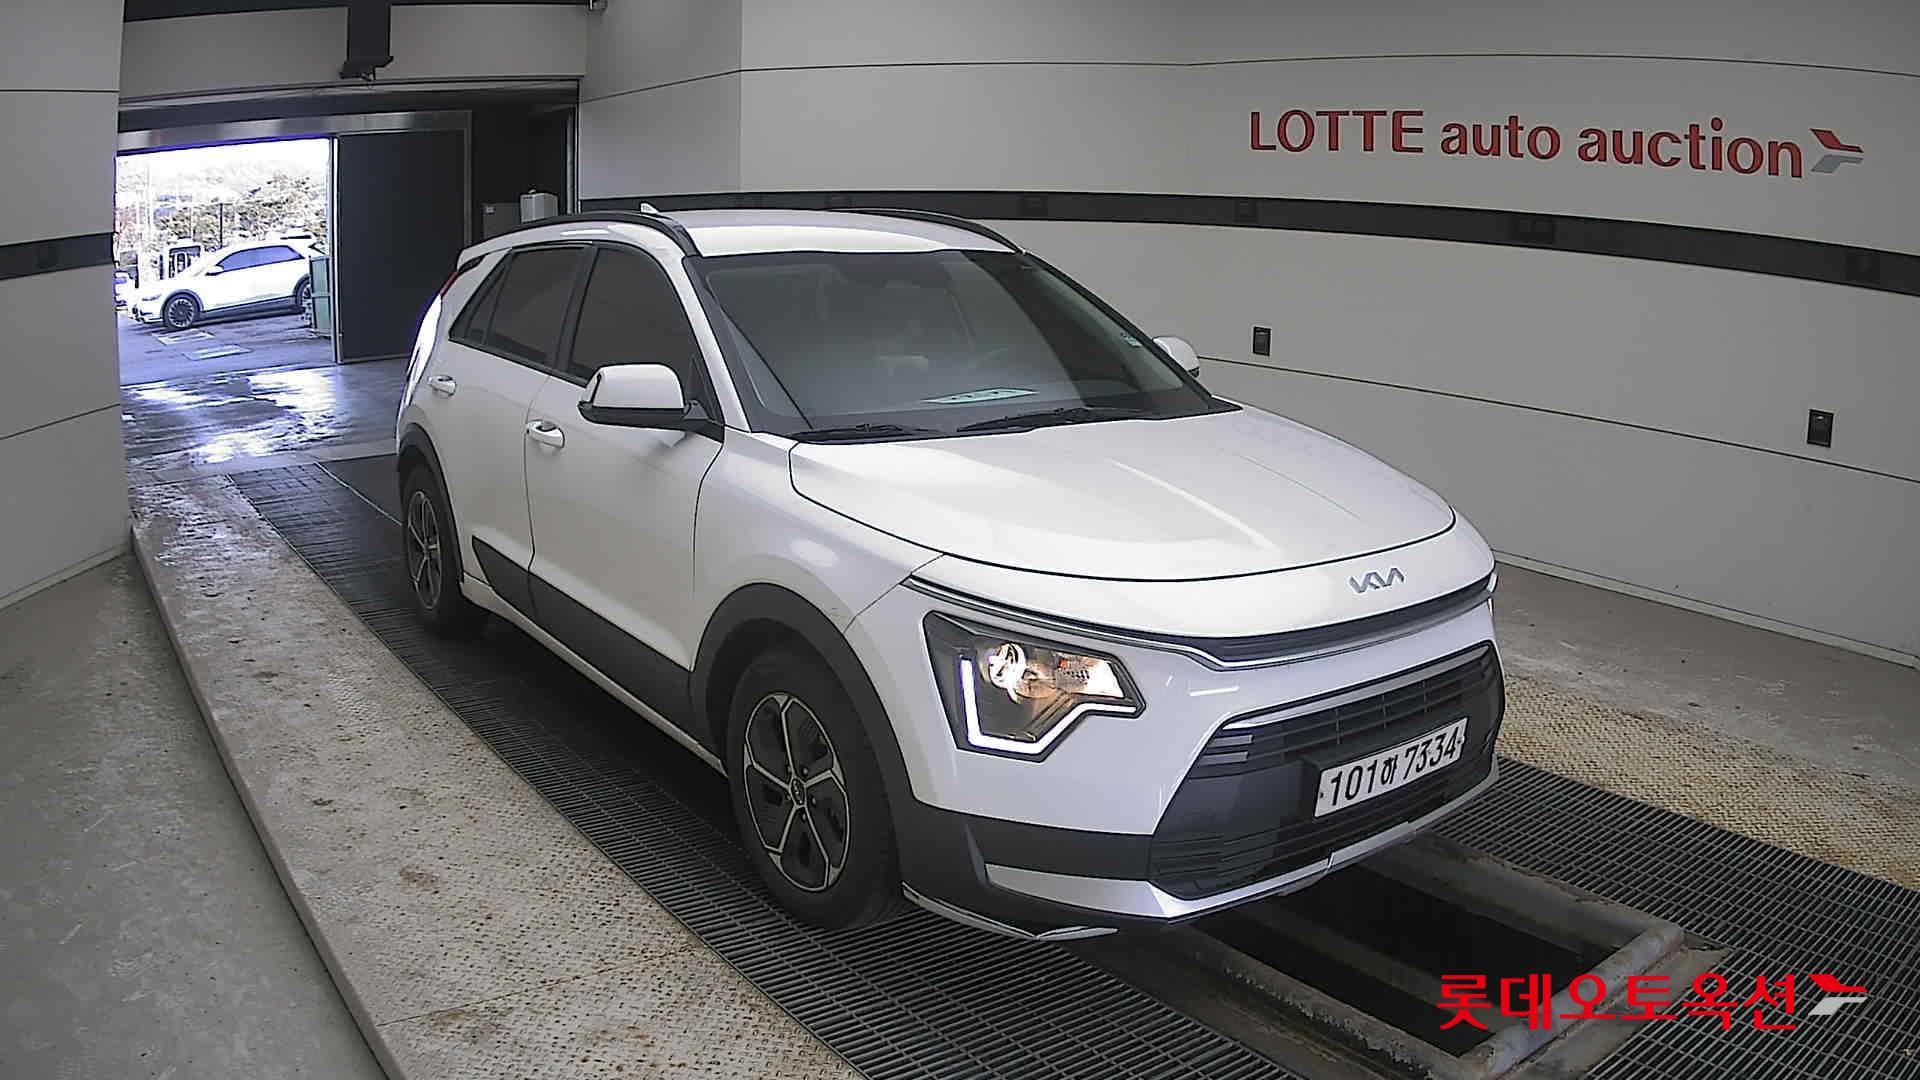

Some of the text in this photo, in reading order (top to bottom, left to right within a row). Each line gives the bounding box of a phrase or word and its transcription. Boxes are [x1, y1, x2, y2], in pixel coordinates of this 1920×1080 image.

[1250, 110, 1804, 178] LOTTE auto auction
[1331, 726, 1458, 806] 101하 7334
